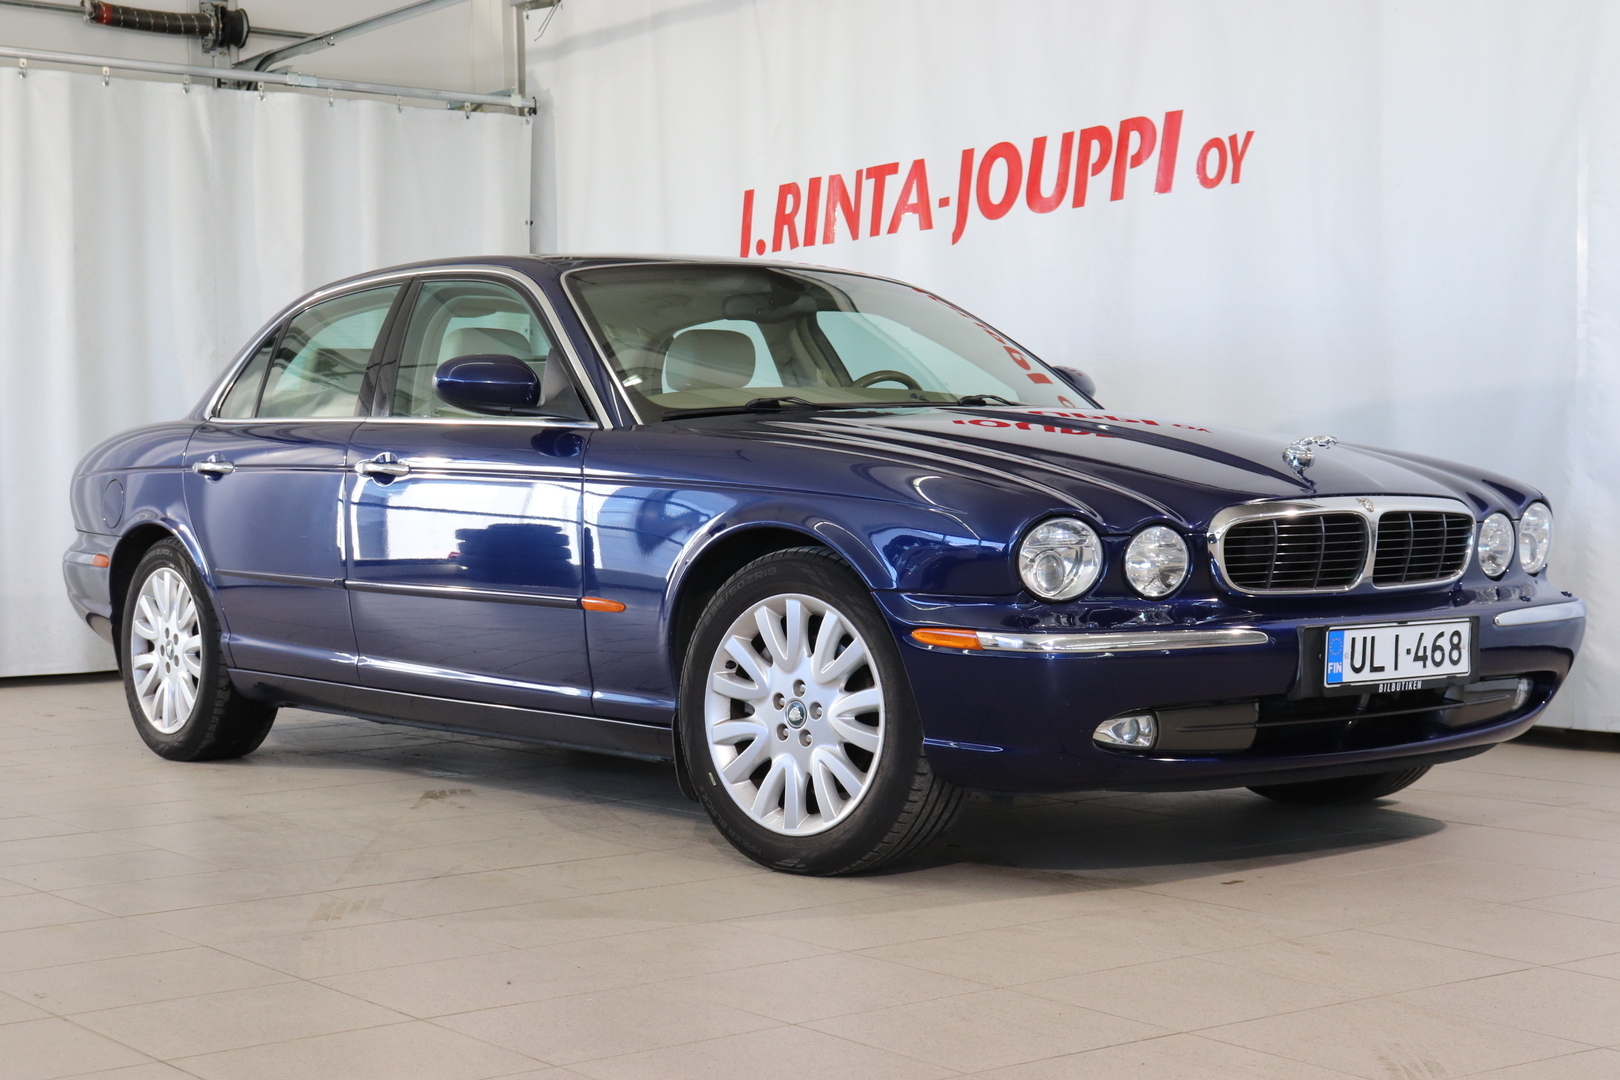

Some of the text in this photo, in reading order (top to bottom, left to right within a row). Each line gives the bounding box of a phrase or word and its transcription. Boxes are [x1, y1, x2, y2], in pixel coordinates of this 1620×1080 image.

[1196, 131, 1255, 189] OY
[1327, 662, 1342, 674] FIN
[1350, 630, 1462, 674] ULI-468
[1379, 681, 1422, 693] BILBUTIKEN
[701, 792, 728, 830] BLACK
